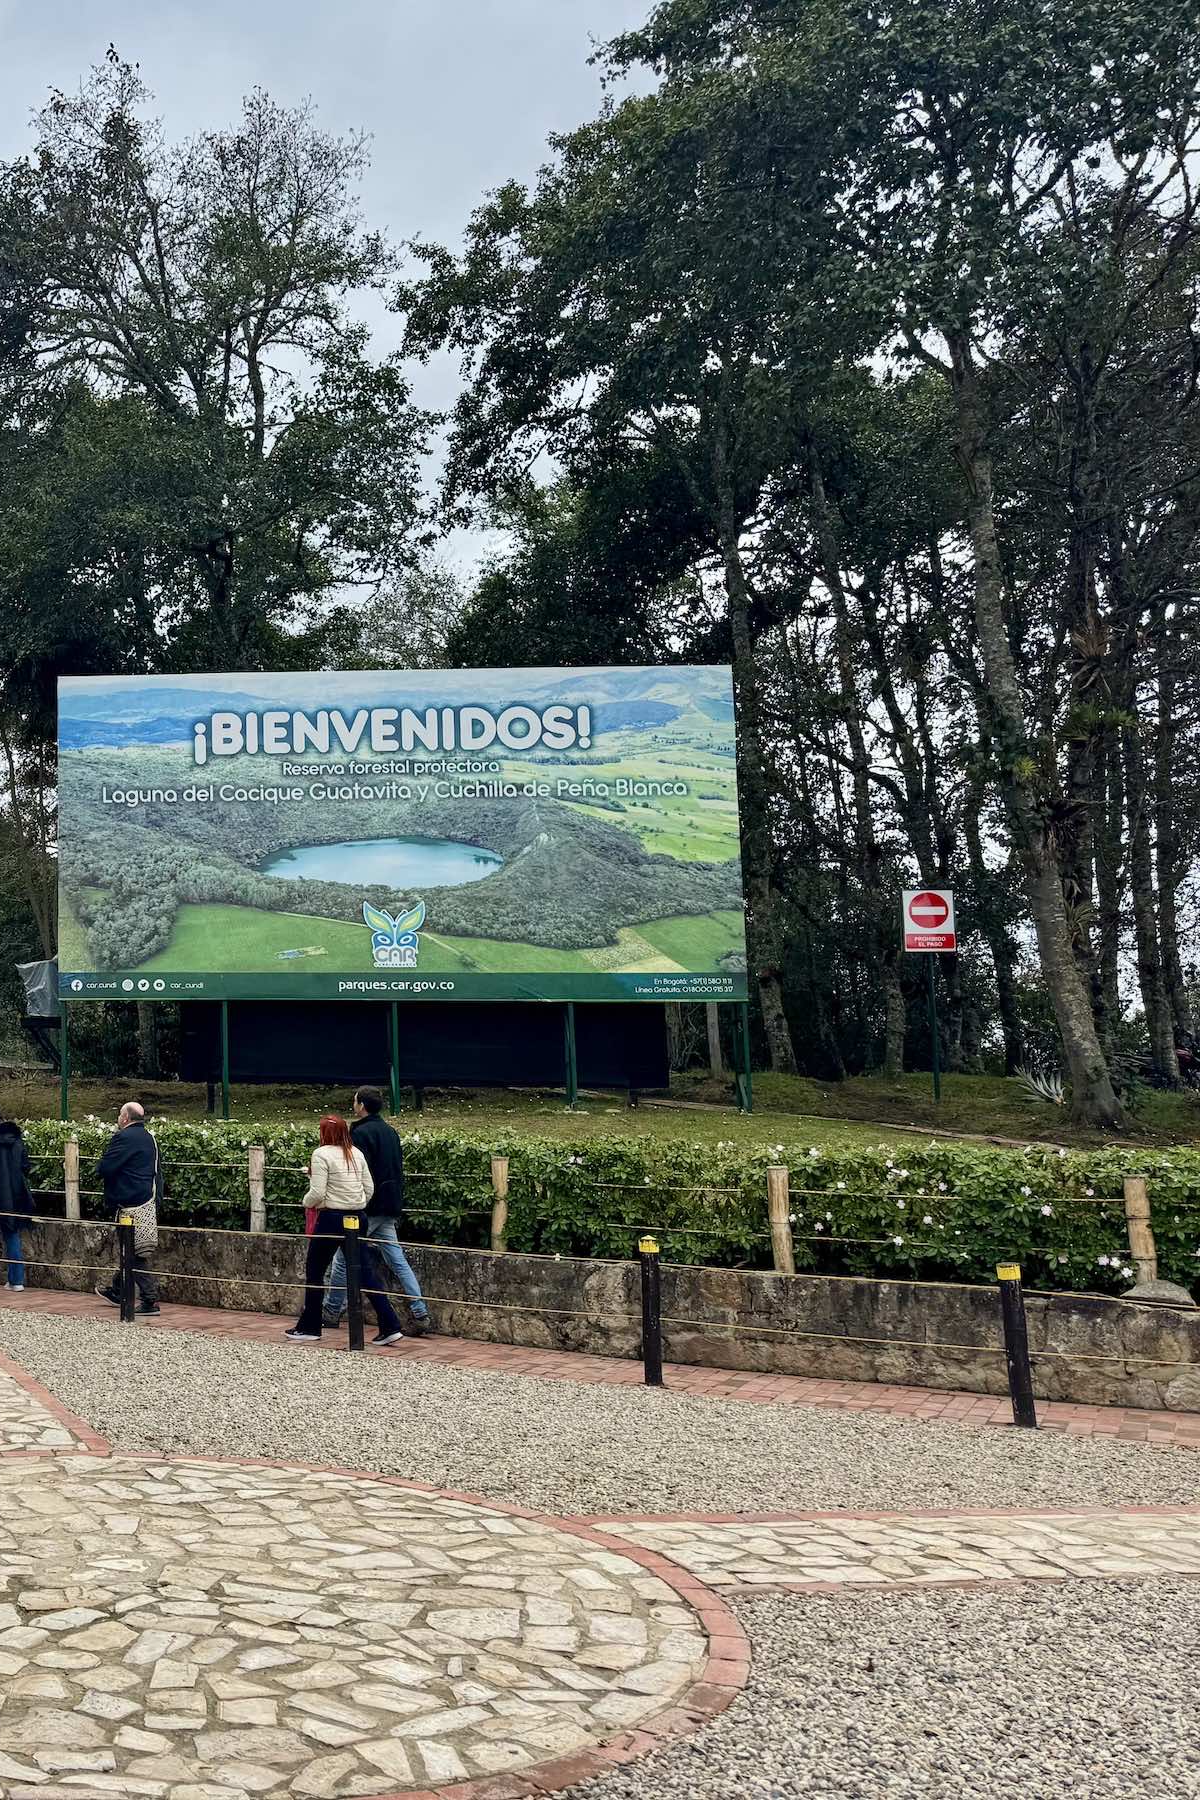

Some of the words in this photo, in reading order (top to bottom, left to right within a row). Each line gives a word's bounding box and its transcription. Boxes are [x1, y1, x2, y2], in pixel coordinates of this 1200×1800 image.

[194, 705, 592, 765] ¡BIENVENIDOS!
[282, 761, 345, 776] Reserva
[349, 759, 410, 775] forestal
[414, 759, 500, 776] protectora
[102, 786, 178, 807] Laguna
[182, 785, 214, 802] del
[218, 784, 304, 804] Cacique
[309, 782, 411, 801] Guatavita
[417, 784, 429, 802] y
[434, 780, 517, 798] Cuchilla
[521, 780, 550, 797] de
[557, 778, 609, 797] Peña
[616, 778, 688, 796] Blanca
[375, 947, 417, 962] CAR
[338, 980, 455, 993] parques.car.gov.co
